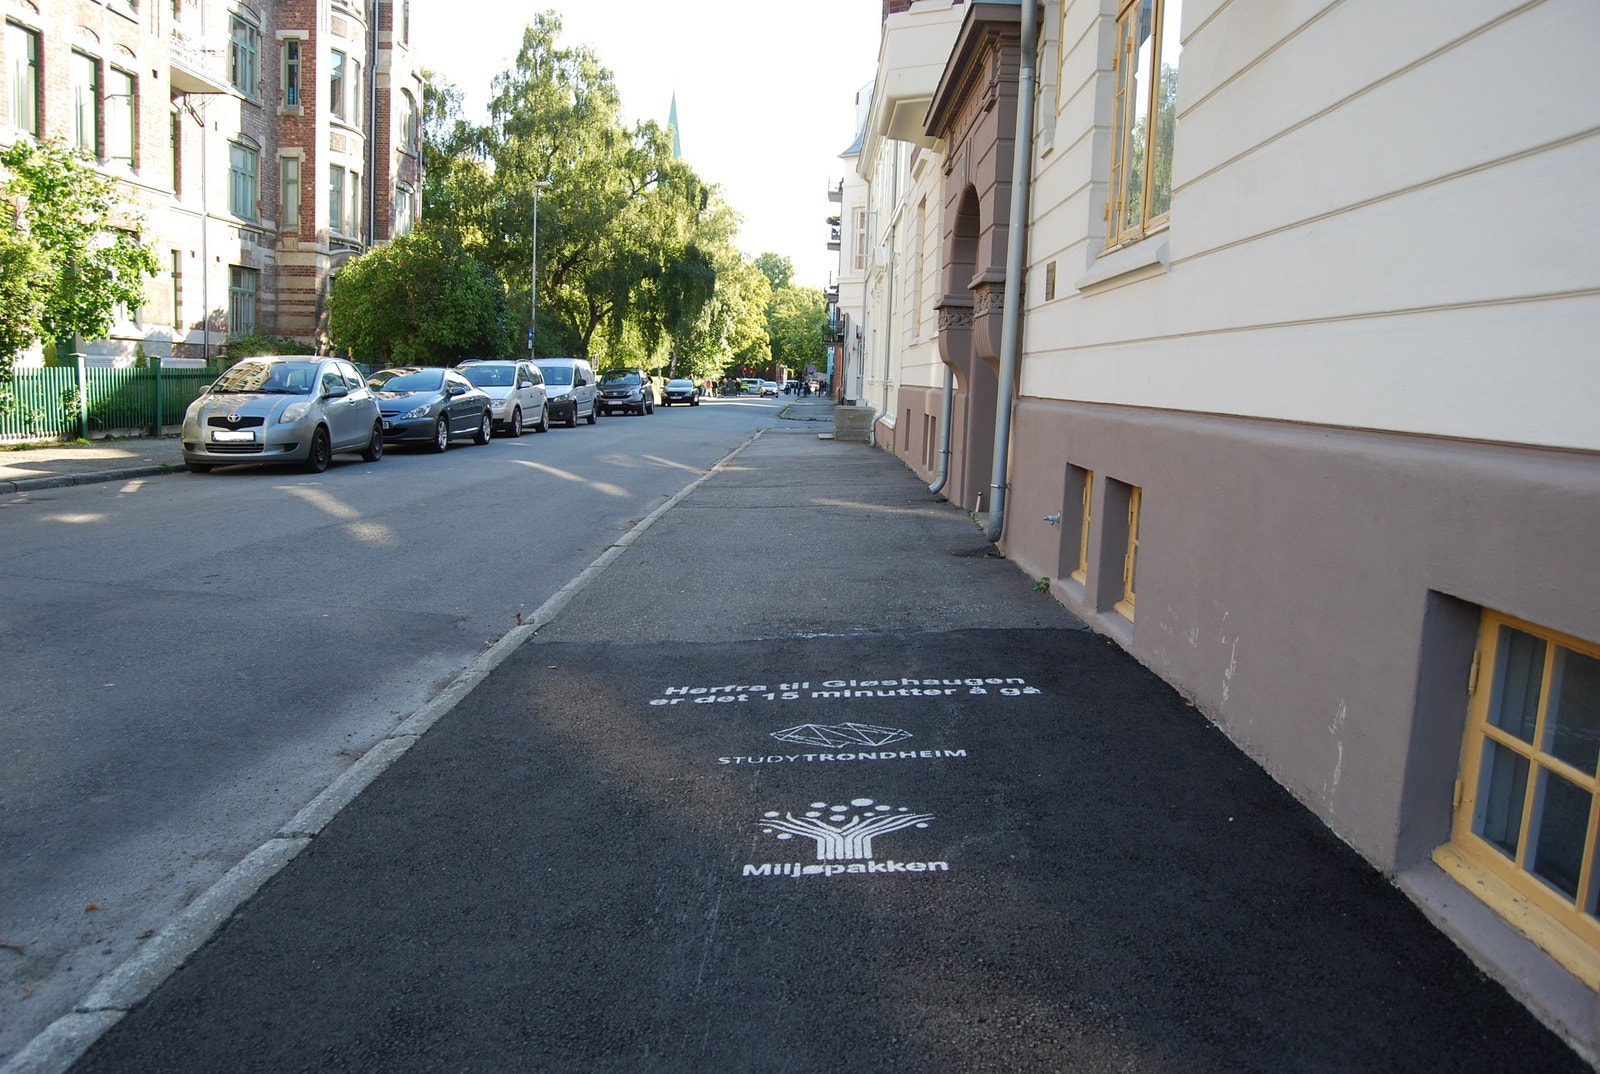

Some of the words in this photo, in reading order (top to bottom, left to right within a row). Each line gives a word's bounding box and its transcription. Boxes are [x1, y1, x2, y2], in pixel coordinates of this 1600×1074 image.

[664, 684, 767, 695] Herfra
[779, 681, 810, 691] til
[822, 678, 1026, 688] Gløshaugen
[649, 698, 686, 706] er
[694, 693, 750, 704] det
[762, 691, 800, 701] 15
[811, 688, 958, 699] minutter
[968, 685, 988, 696] å
[999, 685, 1043, 696] gå
[742, 860, 949, 877] Miljøpakken
